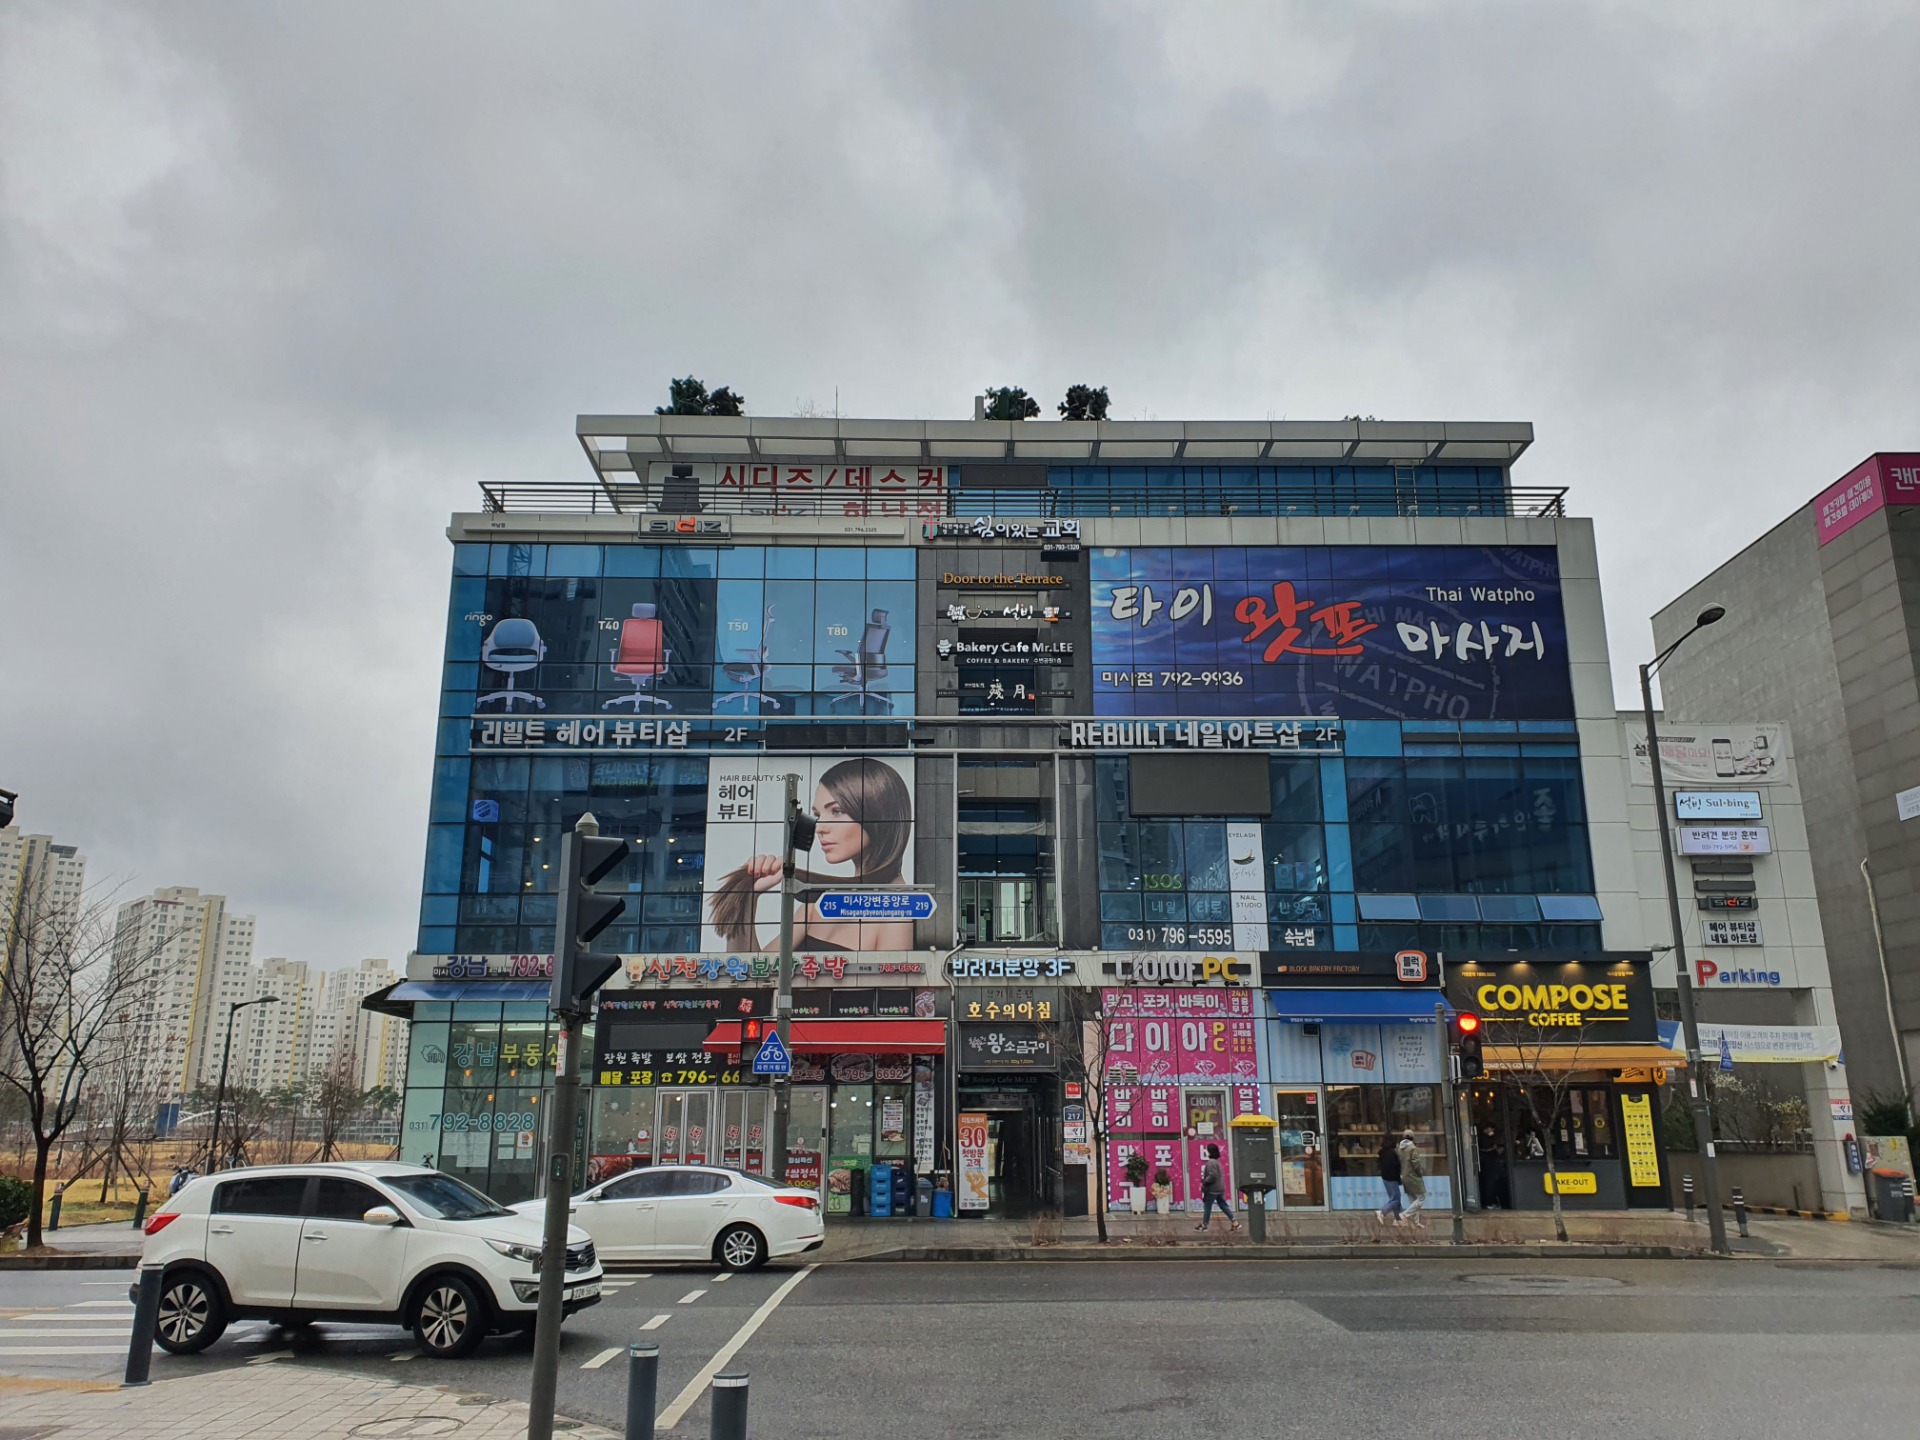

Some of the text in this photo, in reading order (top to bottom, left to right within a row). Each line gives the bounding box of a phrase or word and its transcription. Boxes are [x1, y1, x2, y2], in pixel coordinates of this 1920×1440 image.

[1042, 519, 1081, 539] 교회
[943, 572, 1063, 584] Door to the Terrace
[1425, 586, 1535, 605] Thai Watpho
[598, 618, 620, 631] T40
[727, 620, 749, 632] T50
[1111, 583, 1213, 627] 타이
[1396, 620, 1545, 661] 마사지
[826, 626, 848, 636] T80
[956, 642, 1073, 655] Bakery Cafe Mr.LEE
[1101, 671, 1244, 688] 미사점 792-9936
[481, 720, 748, 747] 리빌트 헤어 뷰티샵 2F
[1071, 722, 1167, 746] REBUILT
[1315, 727, 1338, 742] 2F
[718, 784, 755, 802] 헤어
[1679, 796, 1701, 810] 설빙
[717, 803, 754, 821] 뷰티
[1692, 831, 1718, 840] 반려견
[823, 895, 929, 910] 215 미사강변중앙로 219
[1151, 901, 1176, 914] 네일
[1709, 922, 1755, 931] 헤어 뷰티샵
[1128, 929, 1156, 942] 031)
[1284, 928, 1315, 946] 속눈썹
[1711, 933, 1757, 943] 네일 아트샵
[447, 955, 489, 977] 강남
[878, 963, 921, 973] 796-6692
[952, 958, 1071, 977] 반려견분양 3F
[1115, 954, 1239, 982] 다이아 PC
[1695, 959, 1781, 986] Parking
[1106, 993, 1219, 1009] 맞고 포커 바둑이
[1477, 984, 1629, 1011] COMPOSE
[966, 1001, 1051, 1020] 호수의아침
[1527, 1012, 1582, 1026] COFFEE
[987, 1033, 1050, 1054] 왕소금구이
[1108, 1021, 1209, 1052] 다이아
[453, 1042, 498, 1067] 강남
[604, 1052, 713, 1065] 장원 족발 보쌈 전문
[600, 1070, 623, 1085] 배달
[630, 1071, 653, 1085] 포장
[876, 1068, 904, 1080] 6692
[429, 1113, 535, 1132] 792-8828
[960, 1126, 987, 1148] 30
[785, 1167, 818, 1178] 쌈정식
[1555, 1178, 1589, 1186] AKE-OUT
